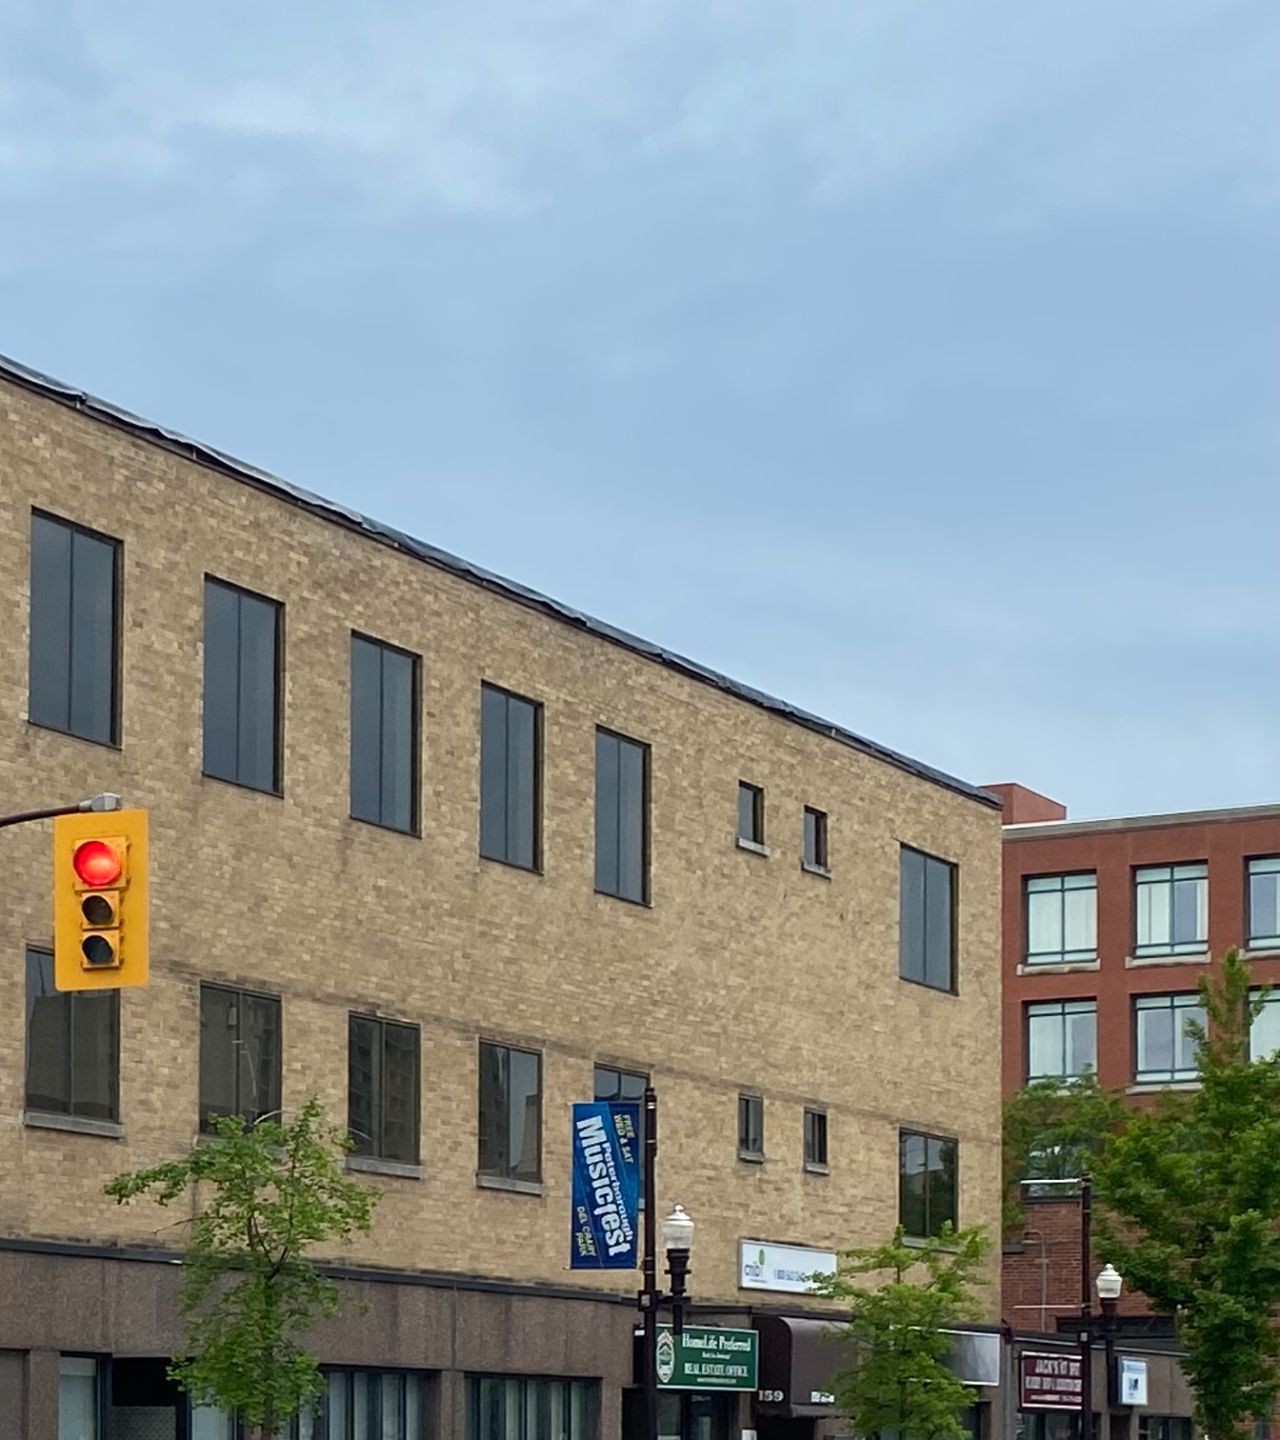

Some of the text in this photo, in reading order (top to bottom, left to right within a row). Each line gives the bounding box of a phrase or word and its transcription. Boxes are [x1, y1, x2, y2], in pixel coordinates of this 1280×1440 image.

[576, 1115, 632, 1257] Musicfest
[601, 1142, 634, 1242] Peterborough
[718, 1335, 752, 1352] Preferred
[758, 1389, 784, 1402] 159
